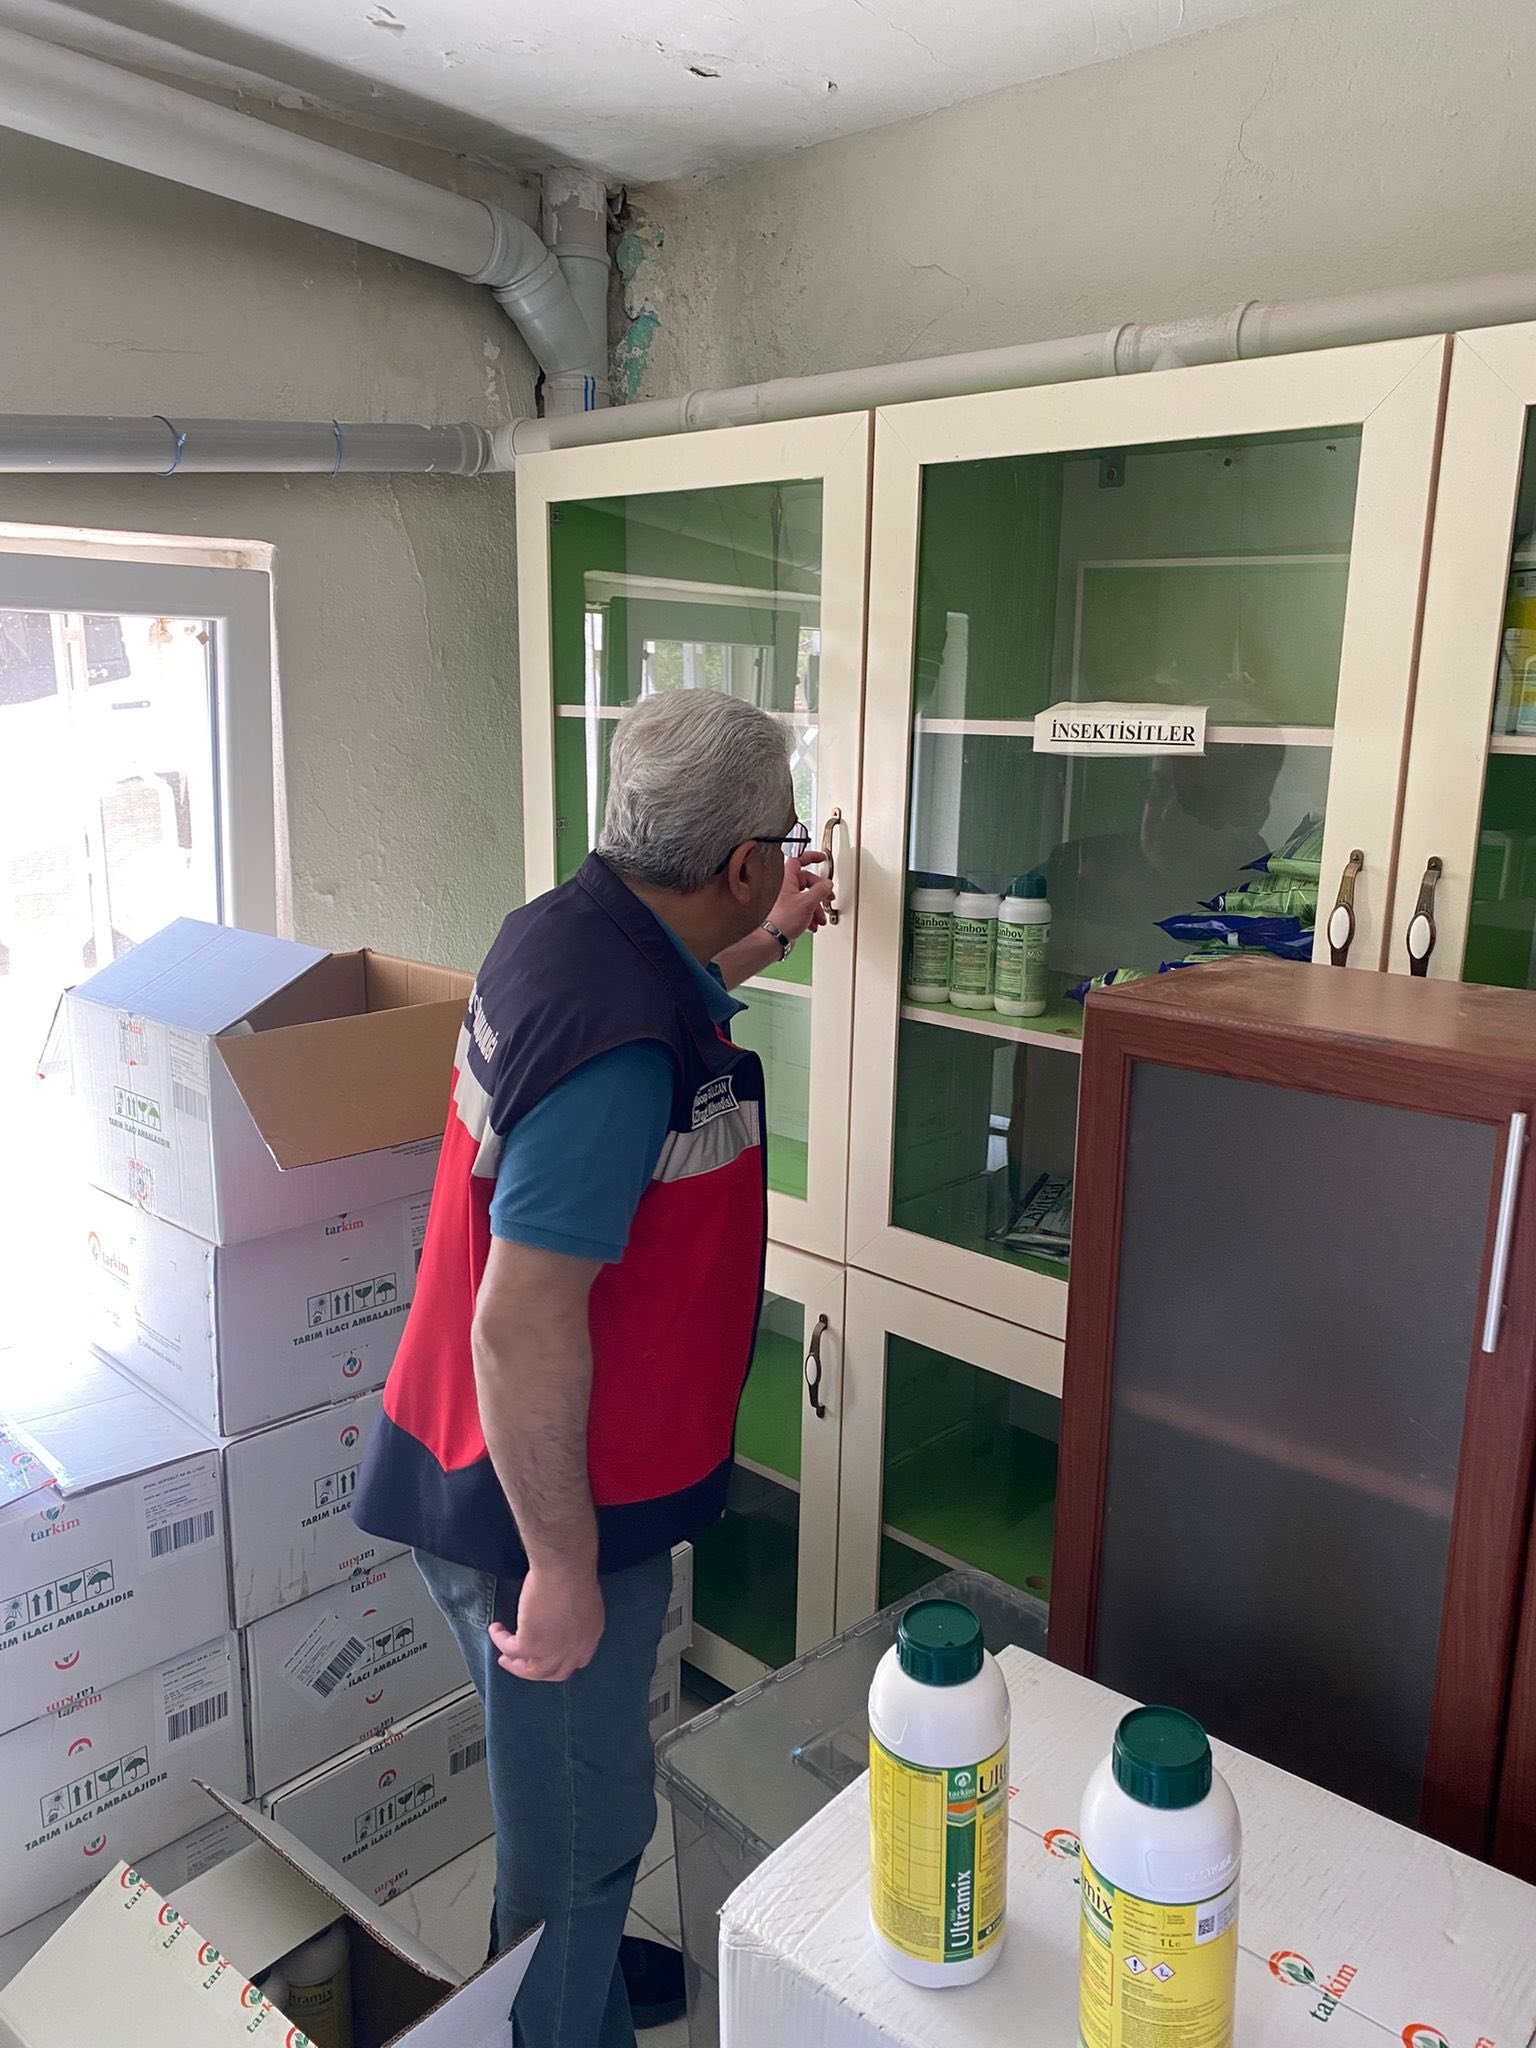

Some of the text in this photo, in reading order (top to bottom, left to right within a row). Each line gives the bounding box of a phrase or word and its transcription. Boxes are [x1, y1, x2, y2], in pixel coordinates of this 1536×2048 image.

[1051, 719, 1196, 742] İNSEKTİSİTLER
[325, 1220, 364, 1236] tarkim
[102, 1251, 129, 1275] tarkim
[293, 1302, 411, 1346] TARIM İLACI AMBALAJIDIR
[301, 1501, 353, 1528] TARIM İLAC
[31, 1518, 80, 1542] tarkim
[338, 1549, 375, 1571] tarkim
[350, 1572, 387, 1593] tarkim
[22, 1622, 53, 1642] İLACI
[57, 1589, 135, 1628] AMBALAJIDIR
[373, 1642, 428, 1676] AMBALAJIDIR
[25, 1772, 168, 1851] TARIM İLACI AMBALAJIDIR
[342, 1796, 448, 1864] TARIM İLACI AMBALAJIDIR
[124, 1882, 151, 1910] tark
[950, 1870, 972, 1948] Ultramix
[162, 1919, 190, 1949] tark
[1160, 1938, 1166, 1947] 1
[203, 1960, 231, 1990] tark
[1309, 1962, 1359, 2024] tarkim
[246, 2002, 274, 2034] tark
